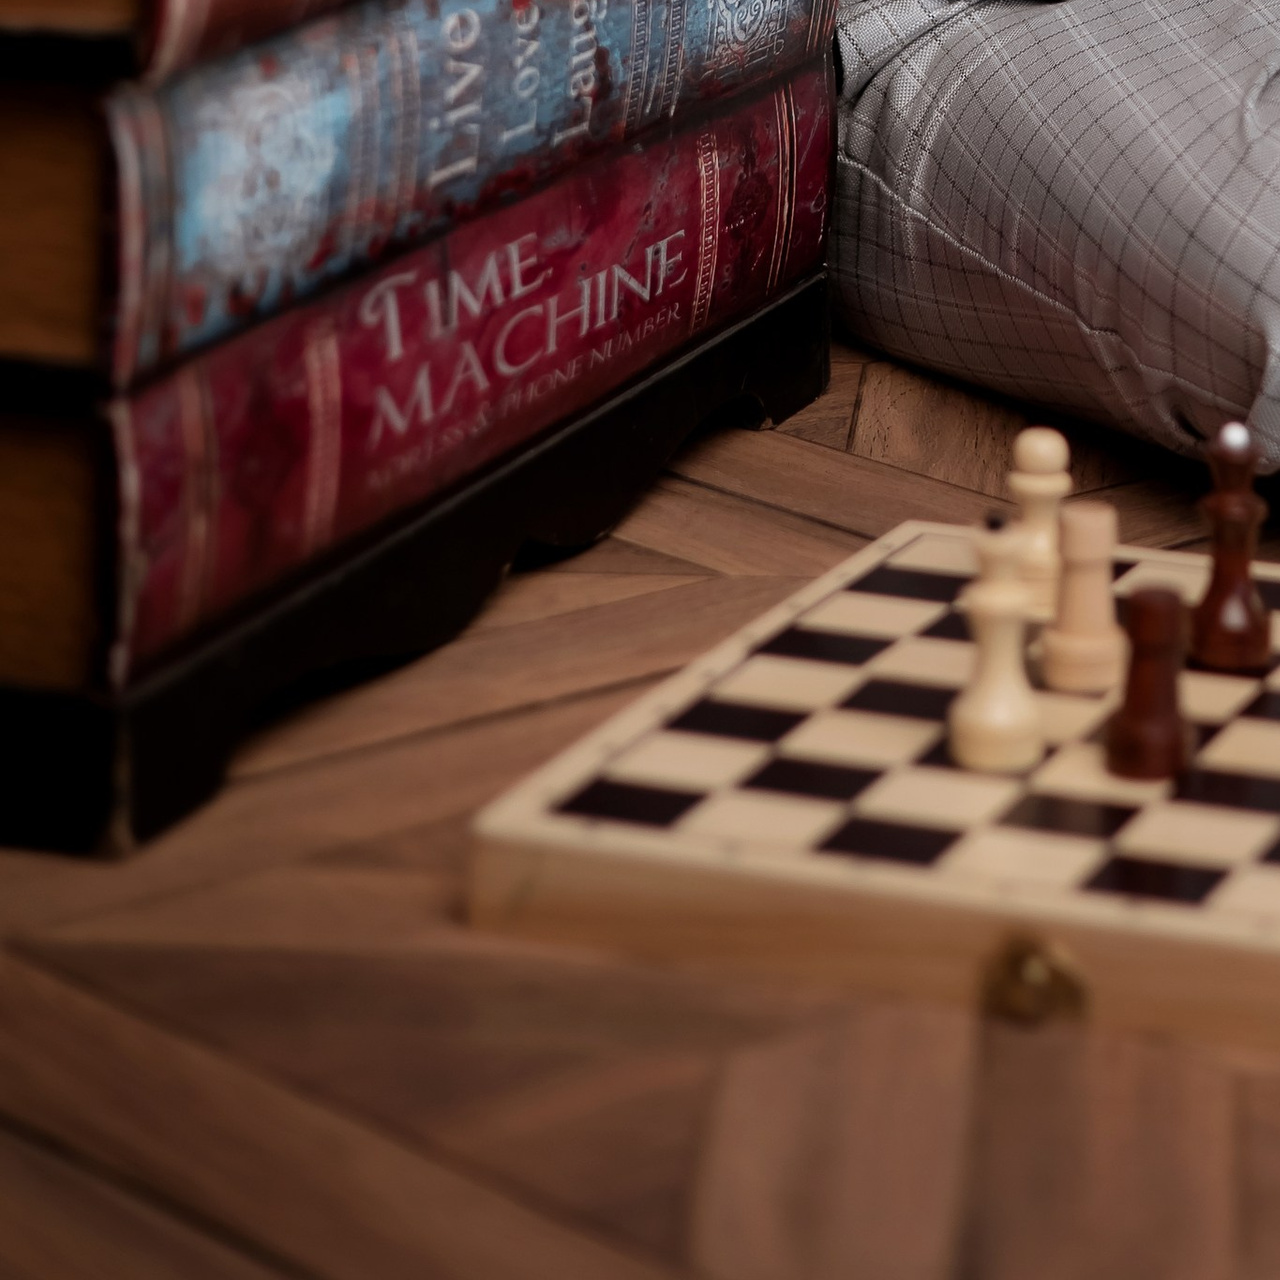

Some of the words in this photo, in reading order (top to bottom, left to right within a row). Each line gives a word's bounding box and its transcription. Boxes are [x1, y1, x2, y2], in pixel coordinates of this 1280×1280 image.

[427, 6, 484, 188] Live
[502, 3, 541, 144] Love
[360, 232, 554, 361] TIME
[368, 229, 688, 450] MACHINE
[503, 355, 584, 419] PHONE
[589, 301, 682, 370] NUMBER
